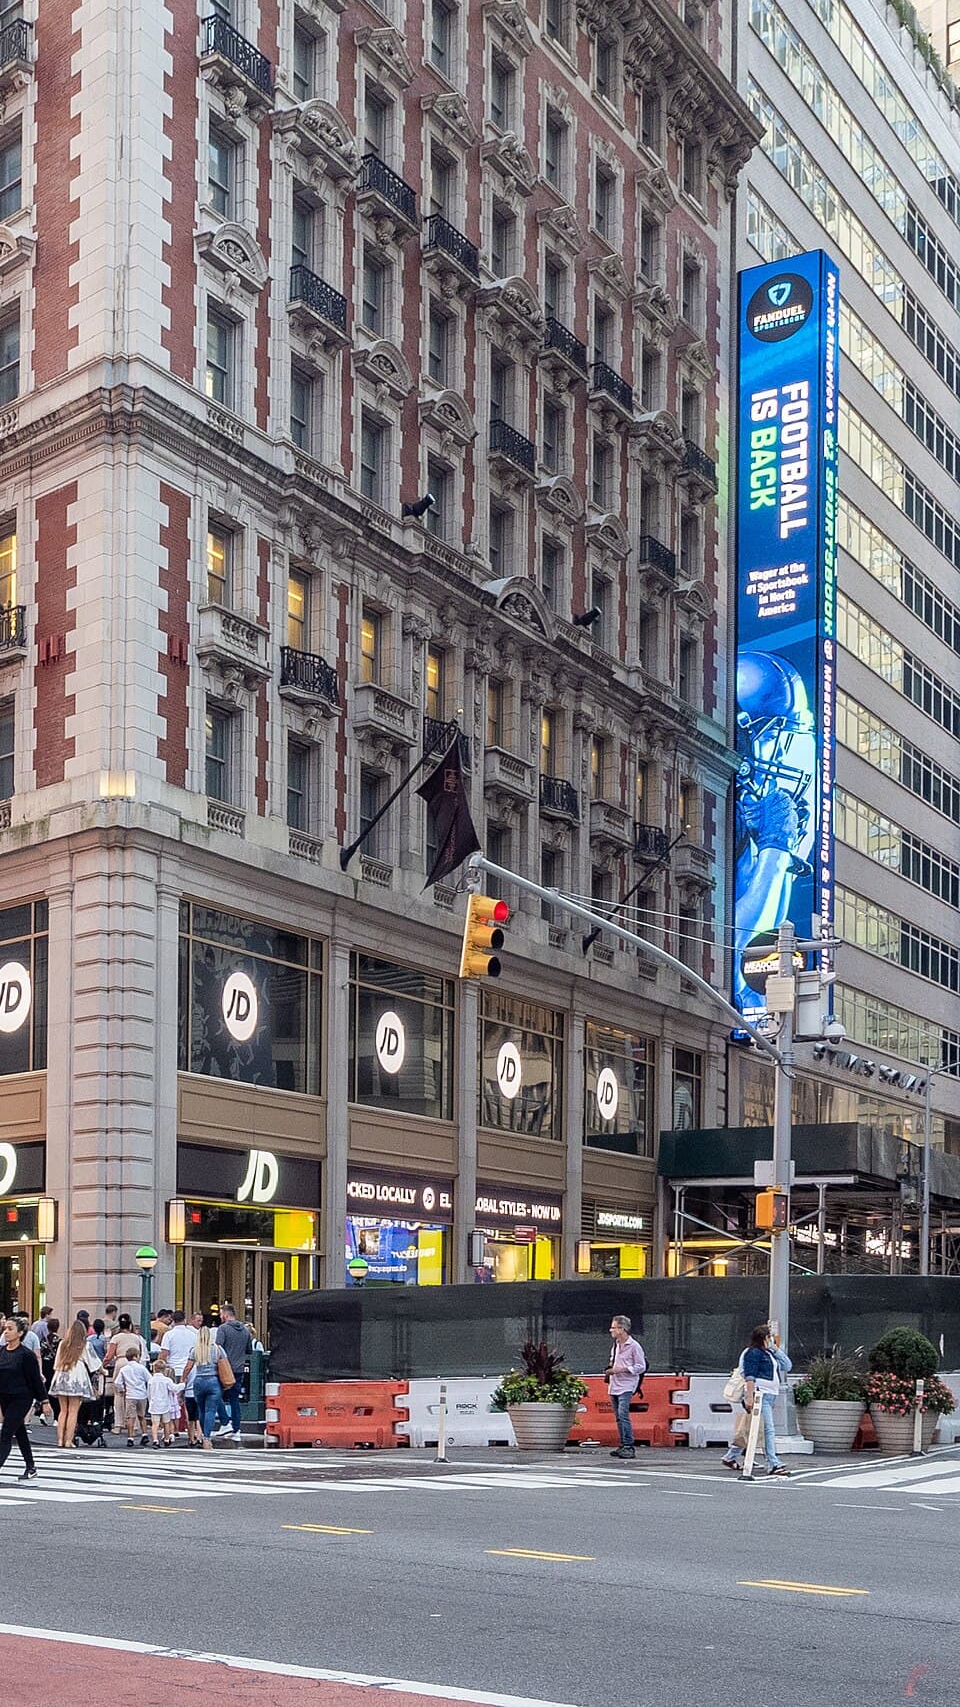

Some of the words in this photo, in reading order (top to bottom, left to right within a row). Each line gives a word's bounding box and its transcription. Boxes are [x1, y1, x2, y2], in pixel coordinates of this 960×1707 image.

[826, 272, 836, 328] North
[753, 314, 805, 333] SPORTSBOOK
[754, 304, 805, 327] FANDUEL
[751, 388, 778, 422] IS
[750, 426, 778, 511] BACK
[780, 380, 809, 540] FOOTBALL
[823, 467, 834, 636] SPORTSBOOK
[749, 568, 778, 582] Wager
[779, 565, 789, 576] at
[789, 562, 805, 574] the
[757, 574, 808, 594] Sportsbook
[757, 602, 796, 618] America
[758, 594, 769, 605] in
[769, 588, 795, 603] North
[822, 664, 832, 794] Meadowlands
[820, 797, 832, 864] Racing
[227, 988, 250, 1022] JD
[380, 1026, 399, 1056] JD
[500, 1055, 516, 1083] JD
[600, 1082, 614, 1105] JD
[237, 1149, 279, 1203] JD
[376, 1184, 416, 1205] LOCALLY
[498, 1200, 526, 1216] STYLES
[531, 1204, 549, 1220] NOW
